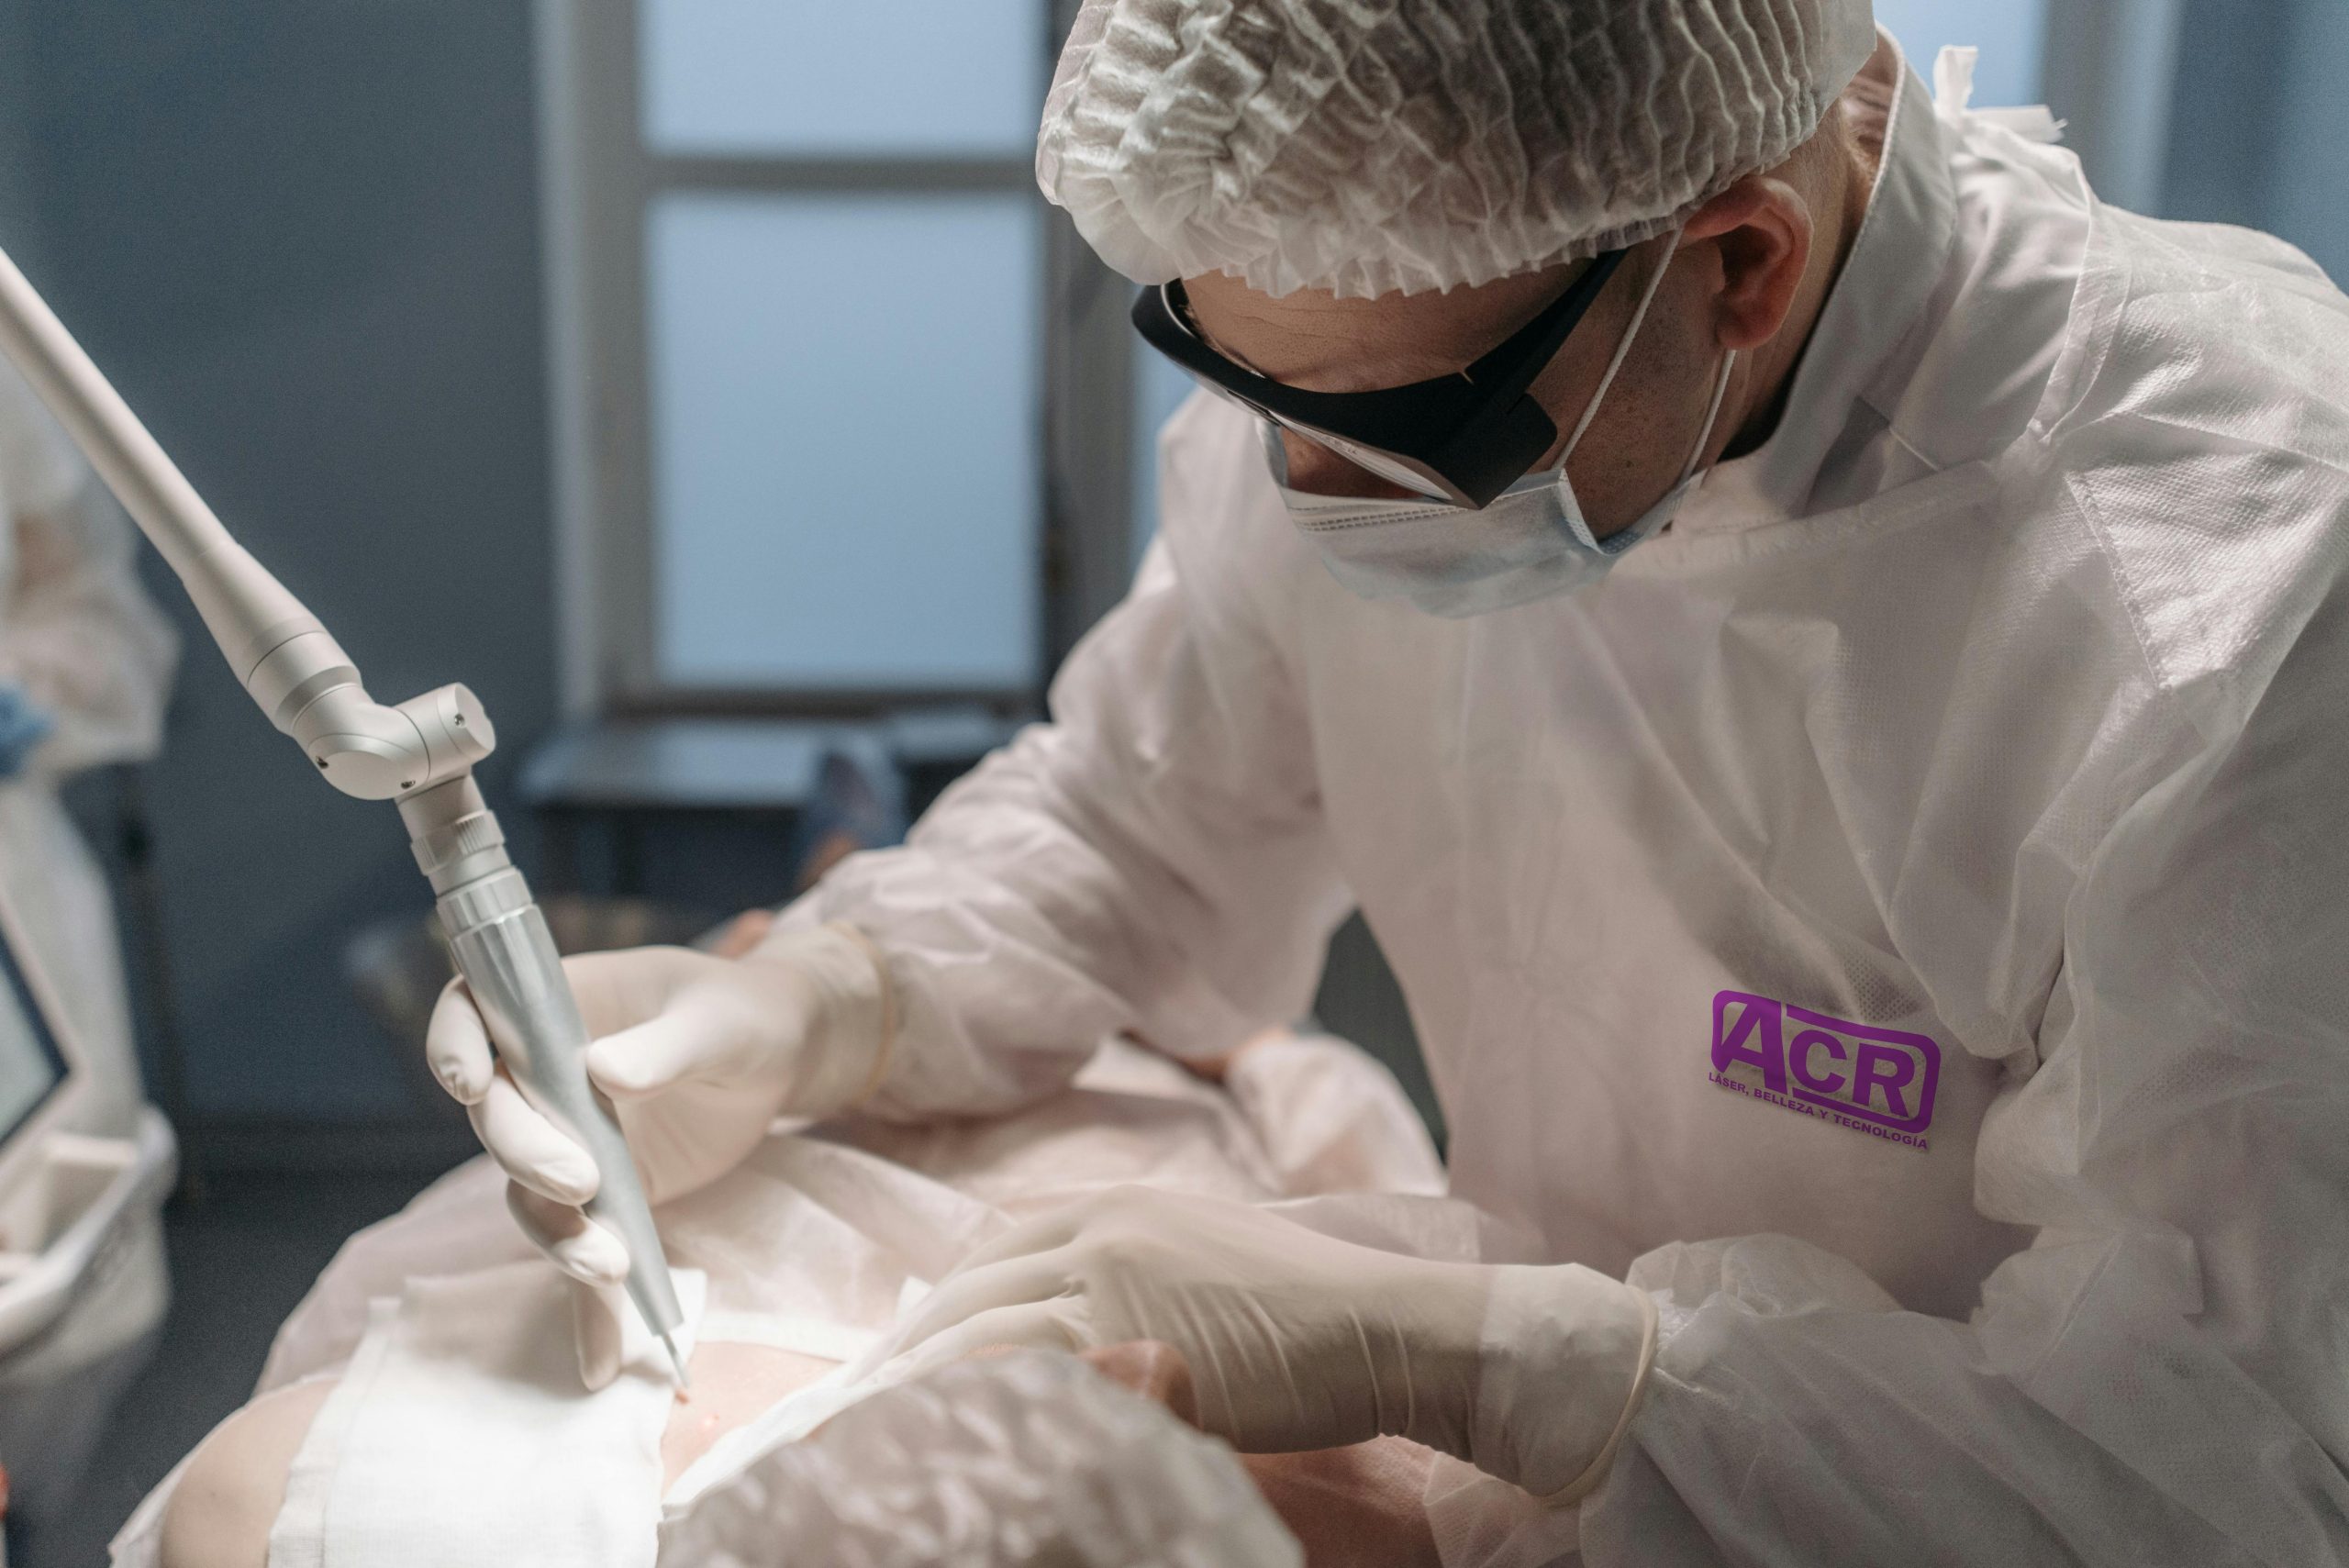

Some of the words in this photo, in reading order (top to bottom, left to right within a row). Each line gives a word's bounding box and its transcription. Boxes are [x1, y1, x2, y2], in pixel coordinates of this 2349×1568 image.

[1712, 990, 1916, 1118] ACR
[1753, 1088, 1815, 1116] BELLEZA
[1820, 1110, 1829, 1120] Y
[1833, 1114, 1928, 1150] TECNOLOGÍA
